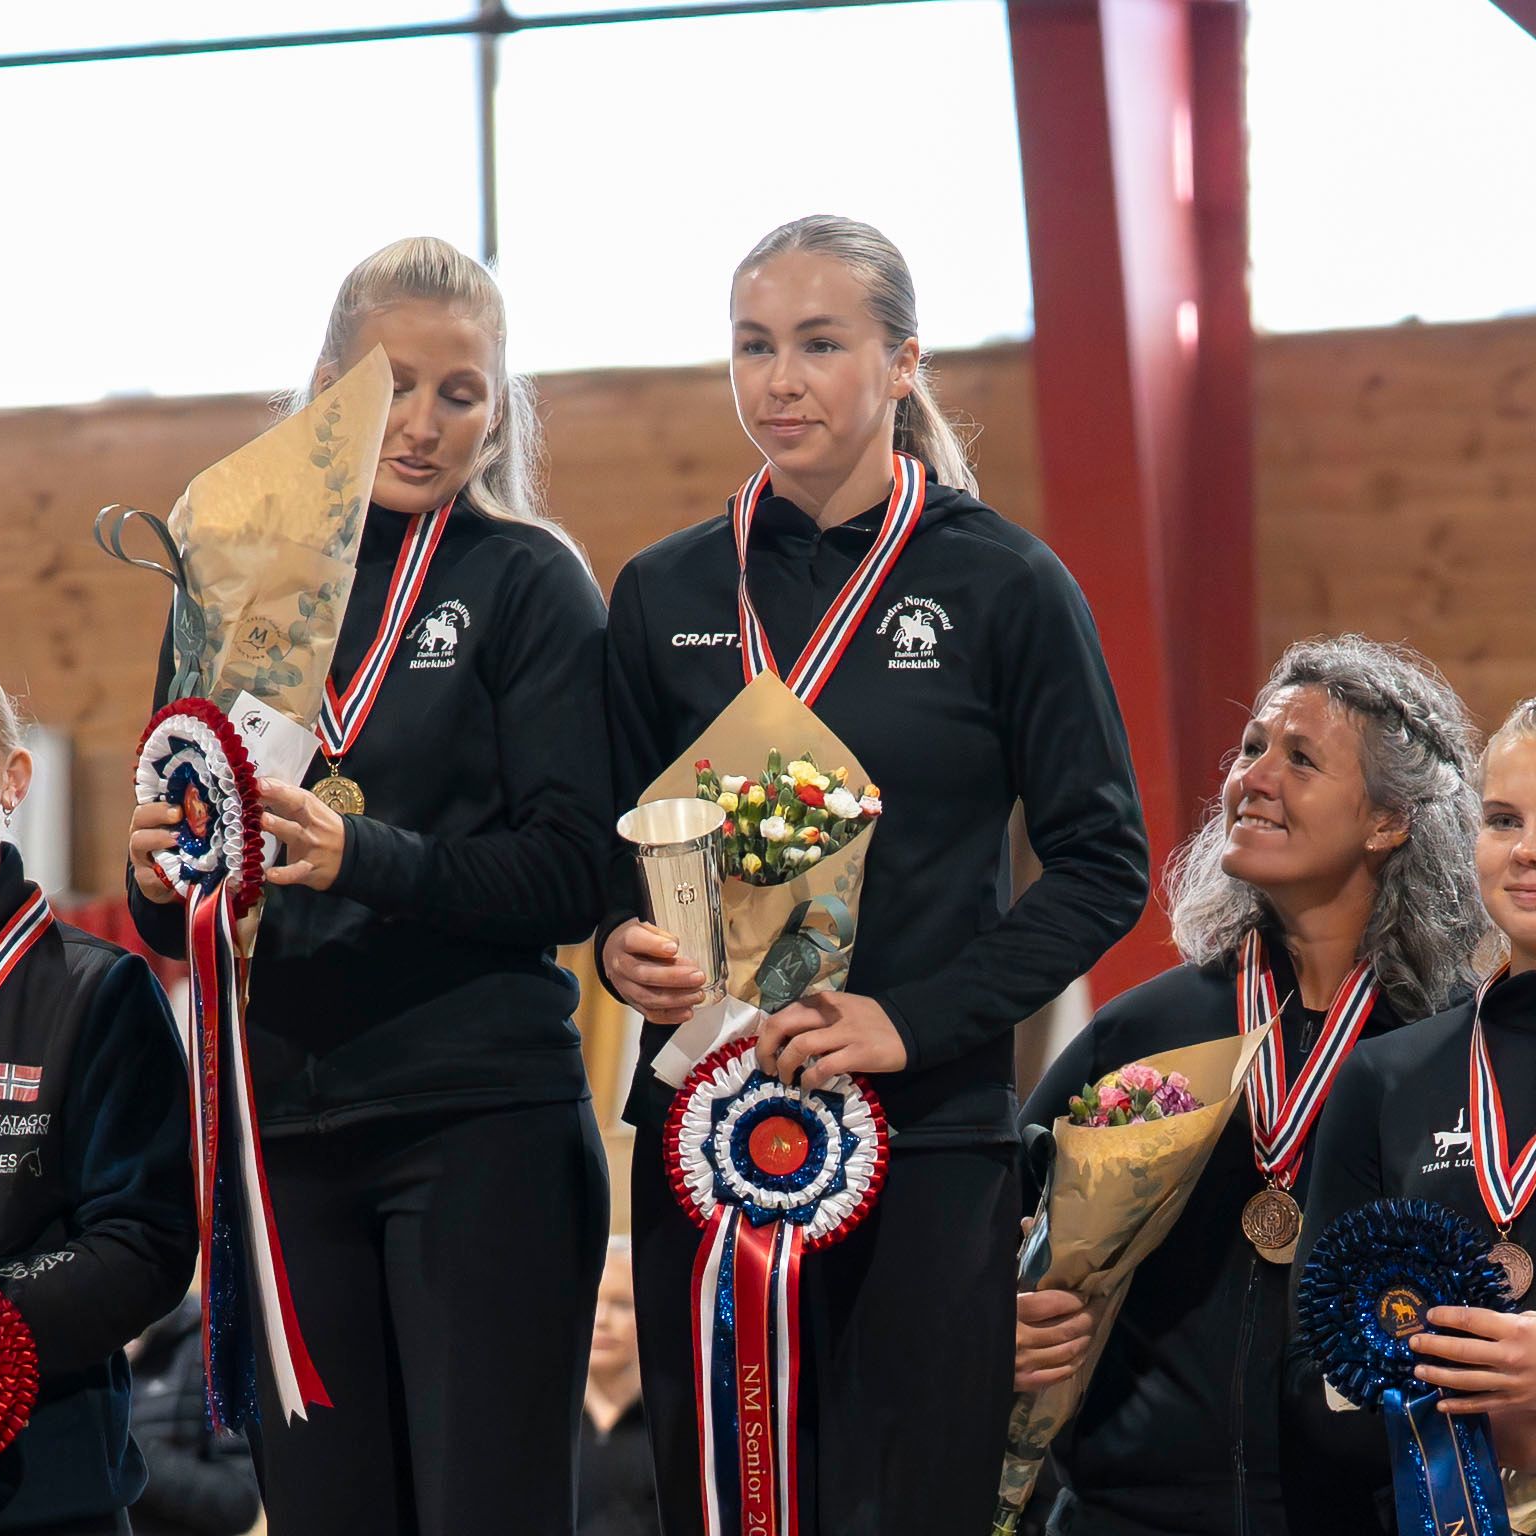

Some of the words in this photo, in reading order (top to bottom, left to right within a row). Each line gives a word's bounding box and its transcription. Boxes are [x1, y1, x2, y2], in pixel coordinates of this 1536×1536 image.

[904, 595, 954, 631] Nordstrand
[249, 626, 268, 643] M
[409, 658, 456, 669] Rideklubb
[888, 658, 941, 669] Rideklubb
[777, 952, 803, 978] M
[1421, 1161, 1450, 1174] TEAM
[1455, 1159, 1476, 1167] LUC
[742, 1363, 762, 1411] NM
[745, 1420, 767, 1504] Senior
